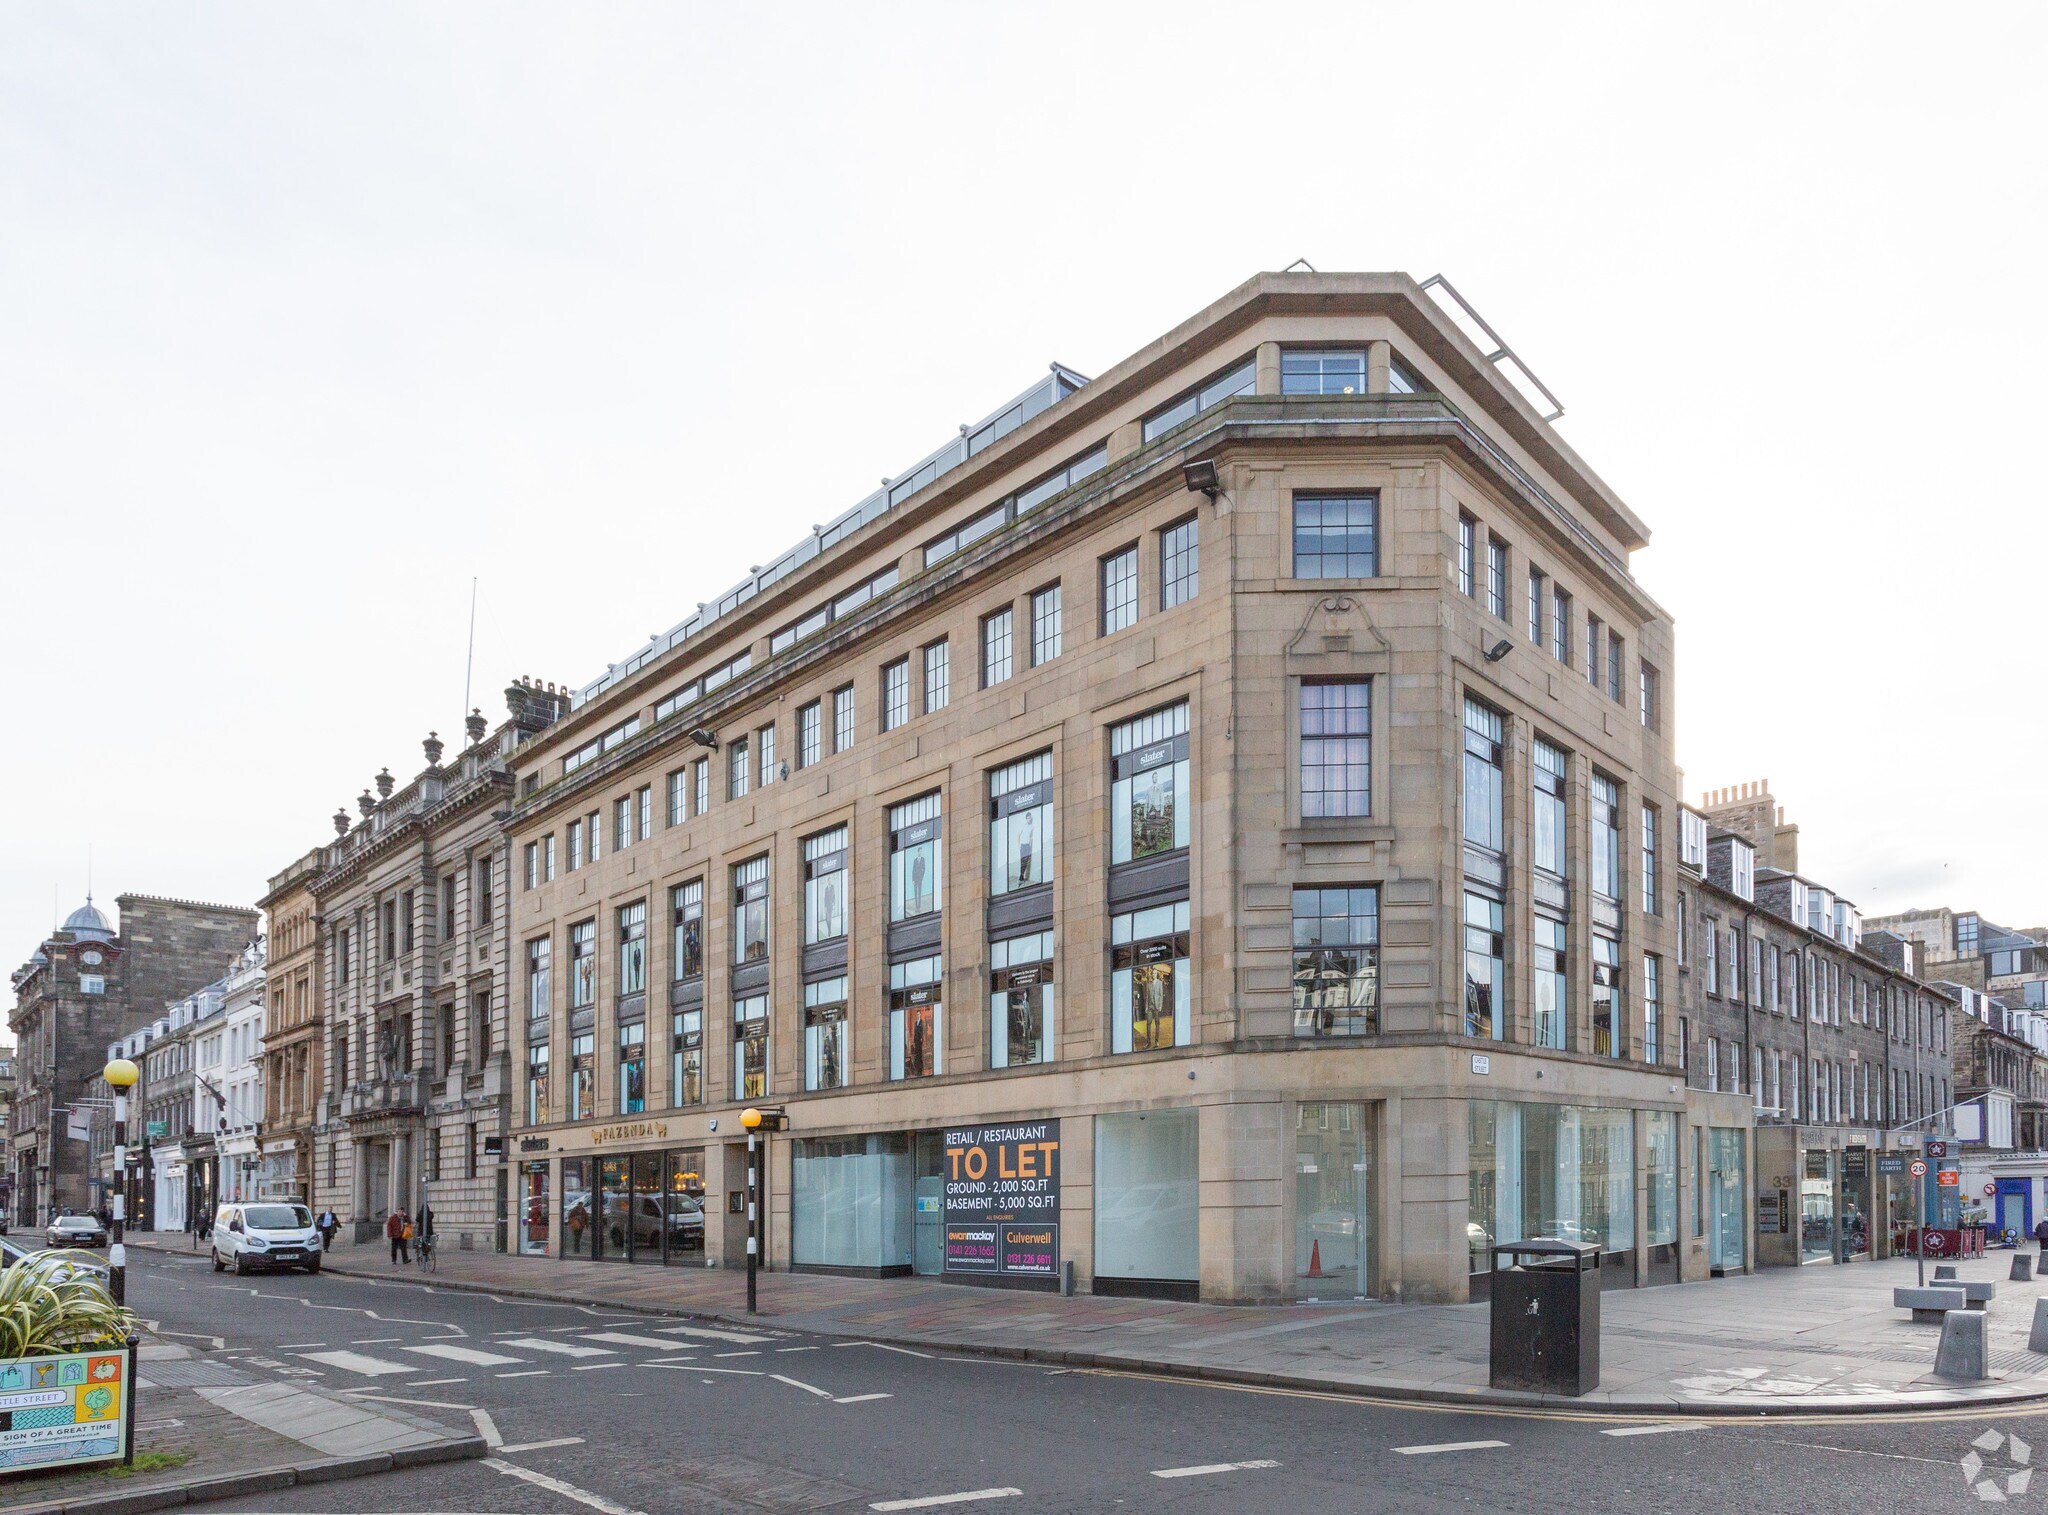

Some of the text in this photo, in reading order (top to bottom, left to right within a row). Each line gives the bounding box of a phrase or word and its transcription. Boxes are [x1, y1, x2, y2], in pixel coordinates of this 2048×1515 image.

[1140, 750, 1165, 764] slater
[1014, 793, 1035, 806] slater
[1474, 1056, 1487, 1064] CASTLE
[603, 1123, 653, 1140] FAZENDA
[947, 1126, 1046, 1146] RETAIL / RESTAURANT
[947, 1142, 1059, 1180] TO LET
[947, 1182, 986, 1194] GROUND
[993, 1181, 1019, 1194] 2,000
[1021, 1179, 1048, 1191] SQ.FT
[1773, 1176, 1790, 1187] 33
[947, 1198, 992, 1209] BASEMENT
[999, 1197, 1025, 1210] 5,000
[1028, 1196, 1055, 1208] SQ.FT
[949, 1231, 995, 1242] ewanmackay
[1007, 1232, 1051, 1243] Culverwell
[949, 1246, 995, 1256] 0141 226 1662
[1007, 1254, 1020, 1263] 0131
[1023, 1254, 1034, 1264] 226
[24, 1394, 58, 1403] STREET
[4, 1433, 27, 1441] SIGN
[57, 1427, 87, 1435] GREAT
